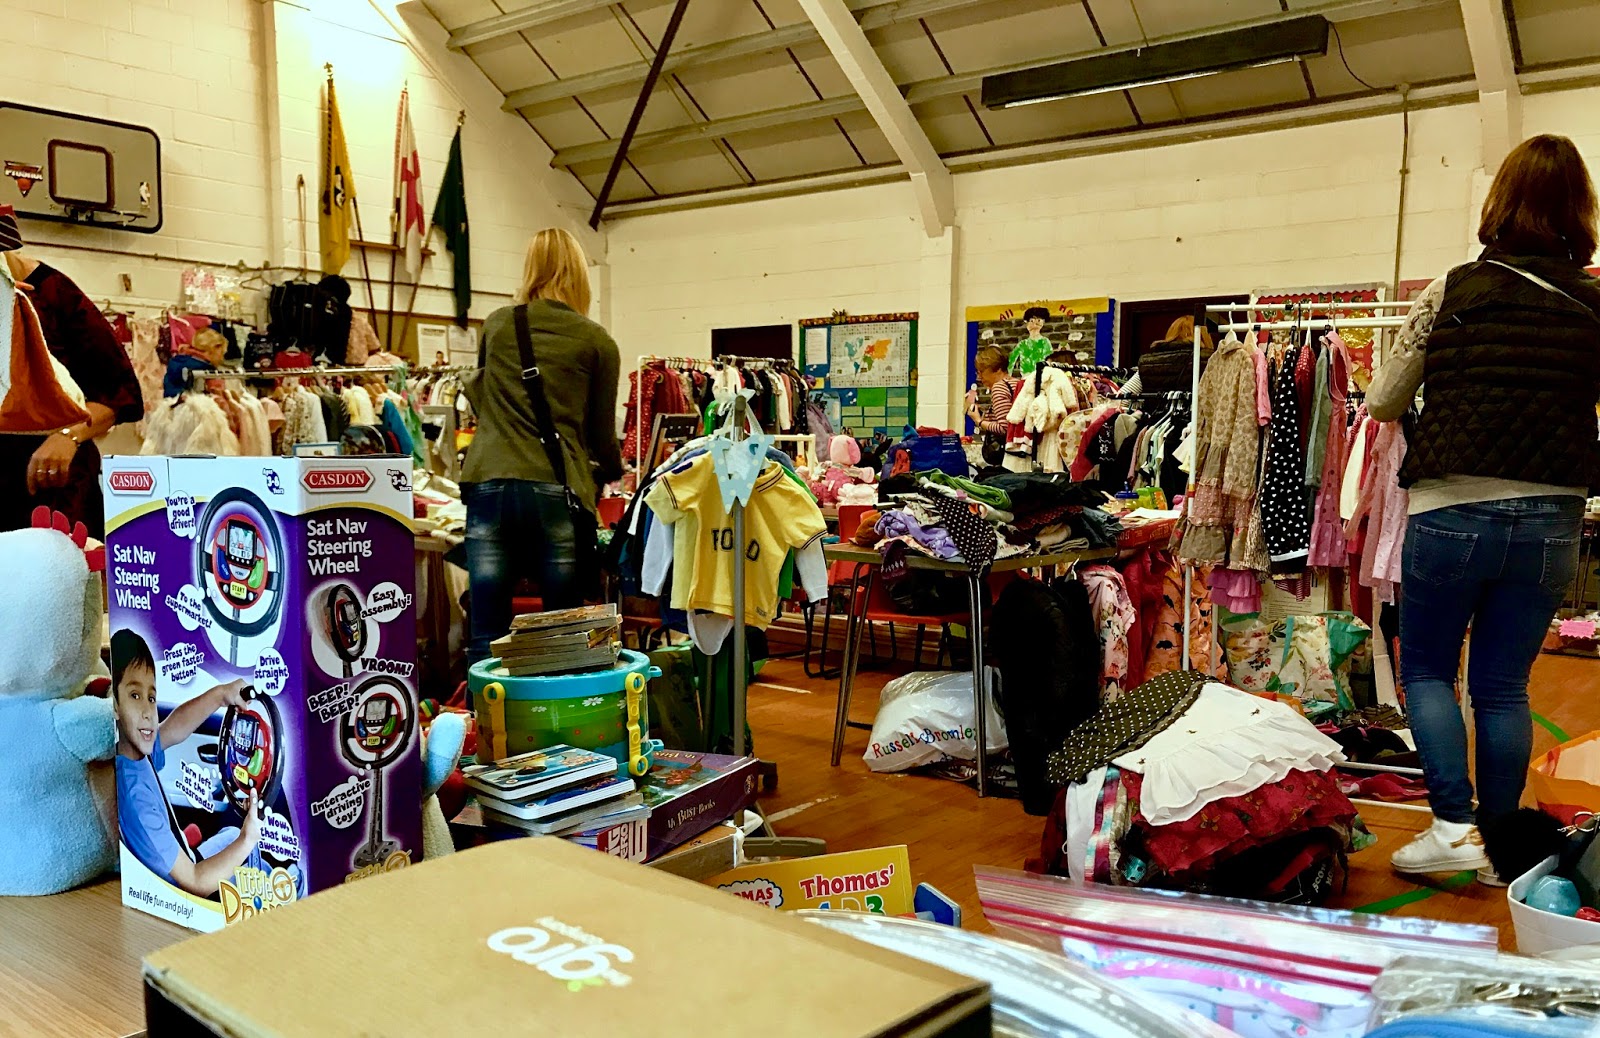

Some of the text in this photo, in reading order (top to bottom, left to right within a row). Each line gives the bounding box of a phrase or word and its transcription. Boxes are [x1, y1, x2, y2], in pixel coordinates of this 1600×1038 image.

[112, 475, 150, 487] CASDON
[309, 473, 365, 486] CASDON
[165, 496, 188, 506] You're
[173, 507, 190, 518] good
[170, 518, 194, 529] driver!
[307, 518, 368, 537] Sat Nav
[307, 537, 372, 557] Steering
[711, 527, 760, 562] FOD
[113, 544, 156, 565] Sat Nav
[307, 555, 360, 576] Wheel
[114, 566, 160, 594] Steering
[231, 584, 245, 594] START
[115, 588, 151, 611] Wheel
[180, 591, 201, 611] To the
[372, 589, 396, 603] Easy
[166, 595, 212, 628] supermarket!
[361, 595, 411, 618] assembly!
[164, 644, 196, 662] Press the
[260, 655, 280, 667] Drive
[162, 654, 204, 676] green faster
[171, 666, 197, 682] button!
[255, 667, 288, 682] straight
[361, 658, 413, 676] VROOM!
[266, 678, 279, 690] on!
[308, 683, 349, 710] BEEP!
[320, 694, 360, 721] BEEP!
[181, 762, 211, 789] Turn left
[184, 776, 205, 795] at the
[175, 780, 214, 811] crossroads!
[312, 780, 370, 814] Interactive
[326, 796, 362, 818] driving
[335, 807, 357, 825] toy!
[267, 816, 290, 832] Wow,
[260, 827, 298, 846] that was
[259, 841, 301, 860] awesome!
[234, 869, 274, 903] Little
[799, 864, 894, 898] Thomas'
[128, 886, 194, 919] Real life fun and play!
